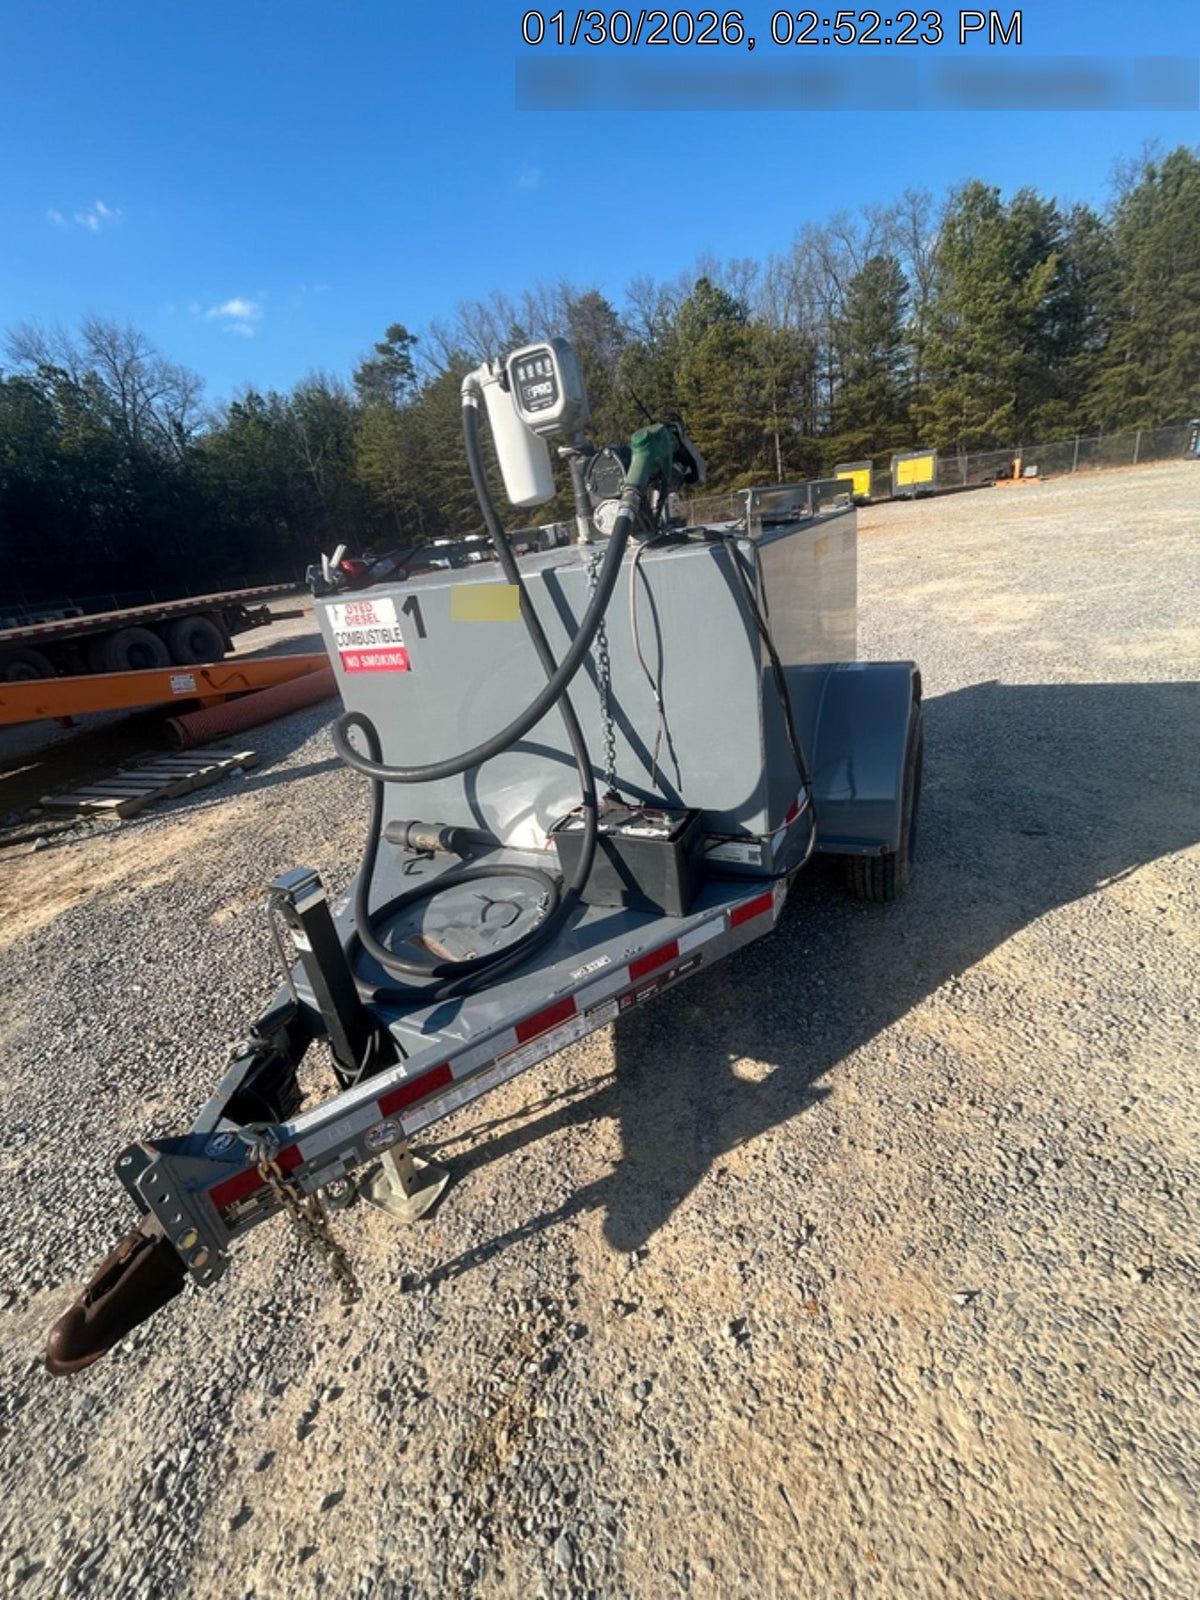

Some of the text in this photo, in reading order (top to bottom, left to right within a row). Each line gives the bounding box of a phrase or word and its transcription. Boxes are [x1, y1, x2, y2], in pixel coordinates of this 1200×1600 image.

[345, 601, 373, 615] DYED
[345, 612, 381, 626] DIESEL
[402, 595, 427, 639] 1
[336, 627, 402, 646] COMBUSTIBLE
[346, 653, 405, 668] NO SMOKING
